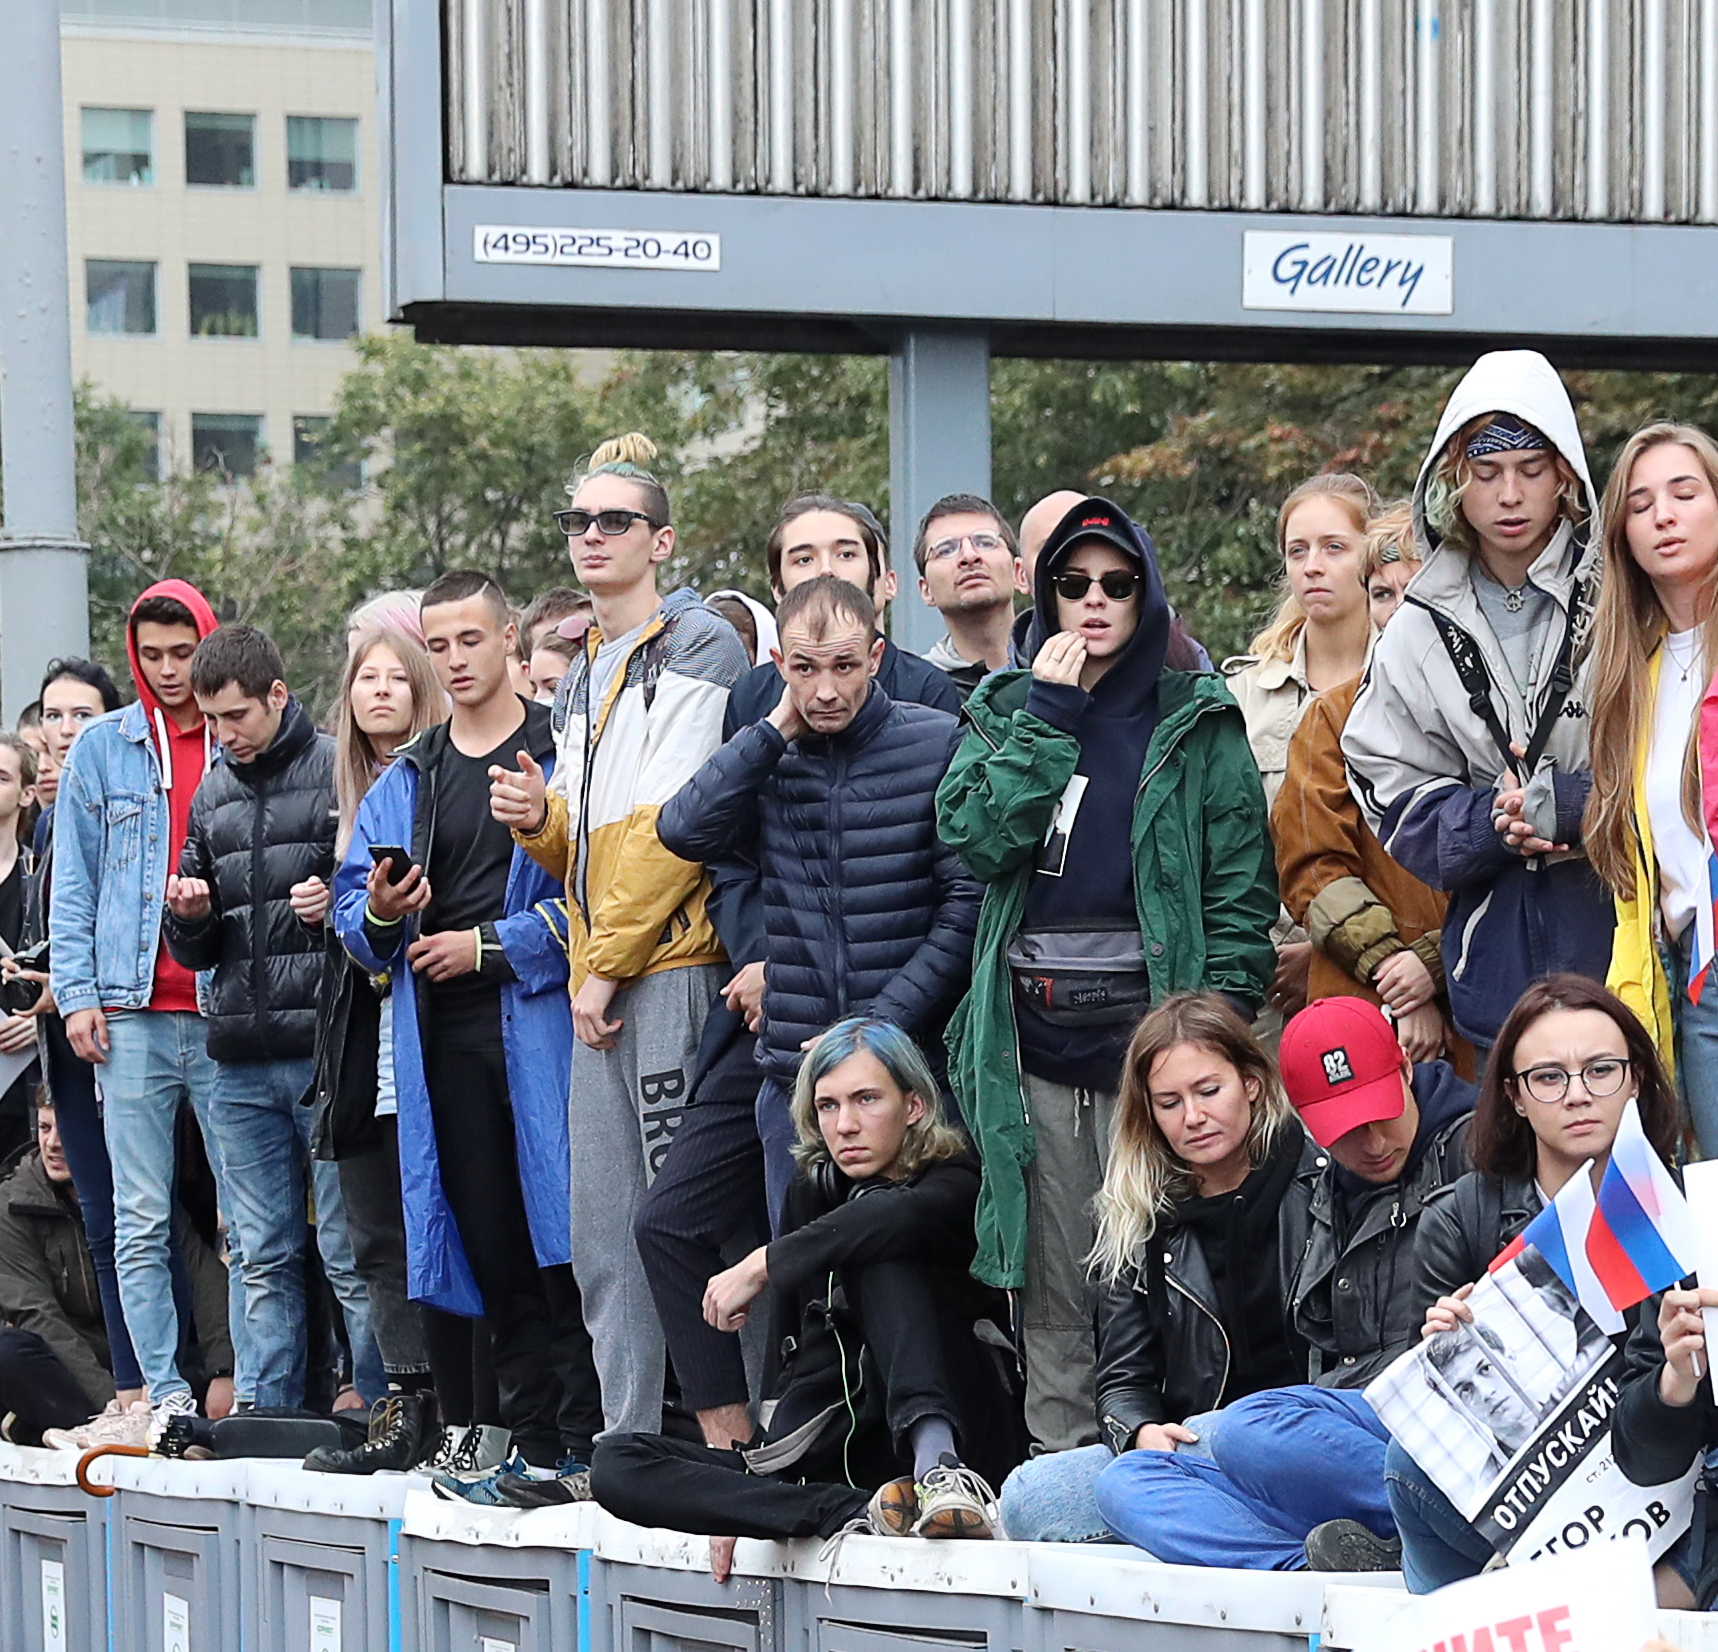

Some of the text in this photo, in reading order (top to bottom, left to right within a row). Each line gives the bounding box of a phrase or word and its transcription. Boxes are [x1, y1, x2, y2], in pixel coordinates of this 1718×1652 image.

[483, 232, 712, 261] (495)225-20-40
[1271, 243, 1425, 308] Gallery
[1493, 1376, 1620, 1532] ОТПУСКАЙ!
